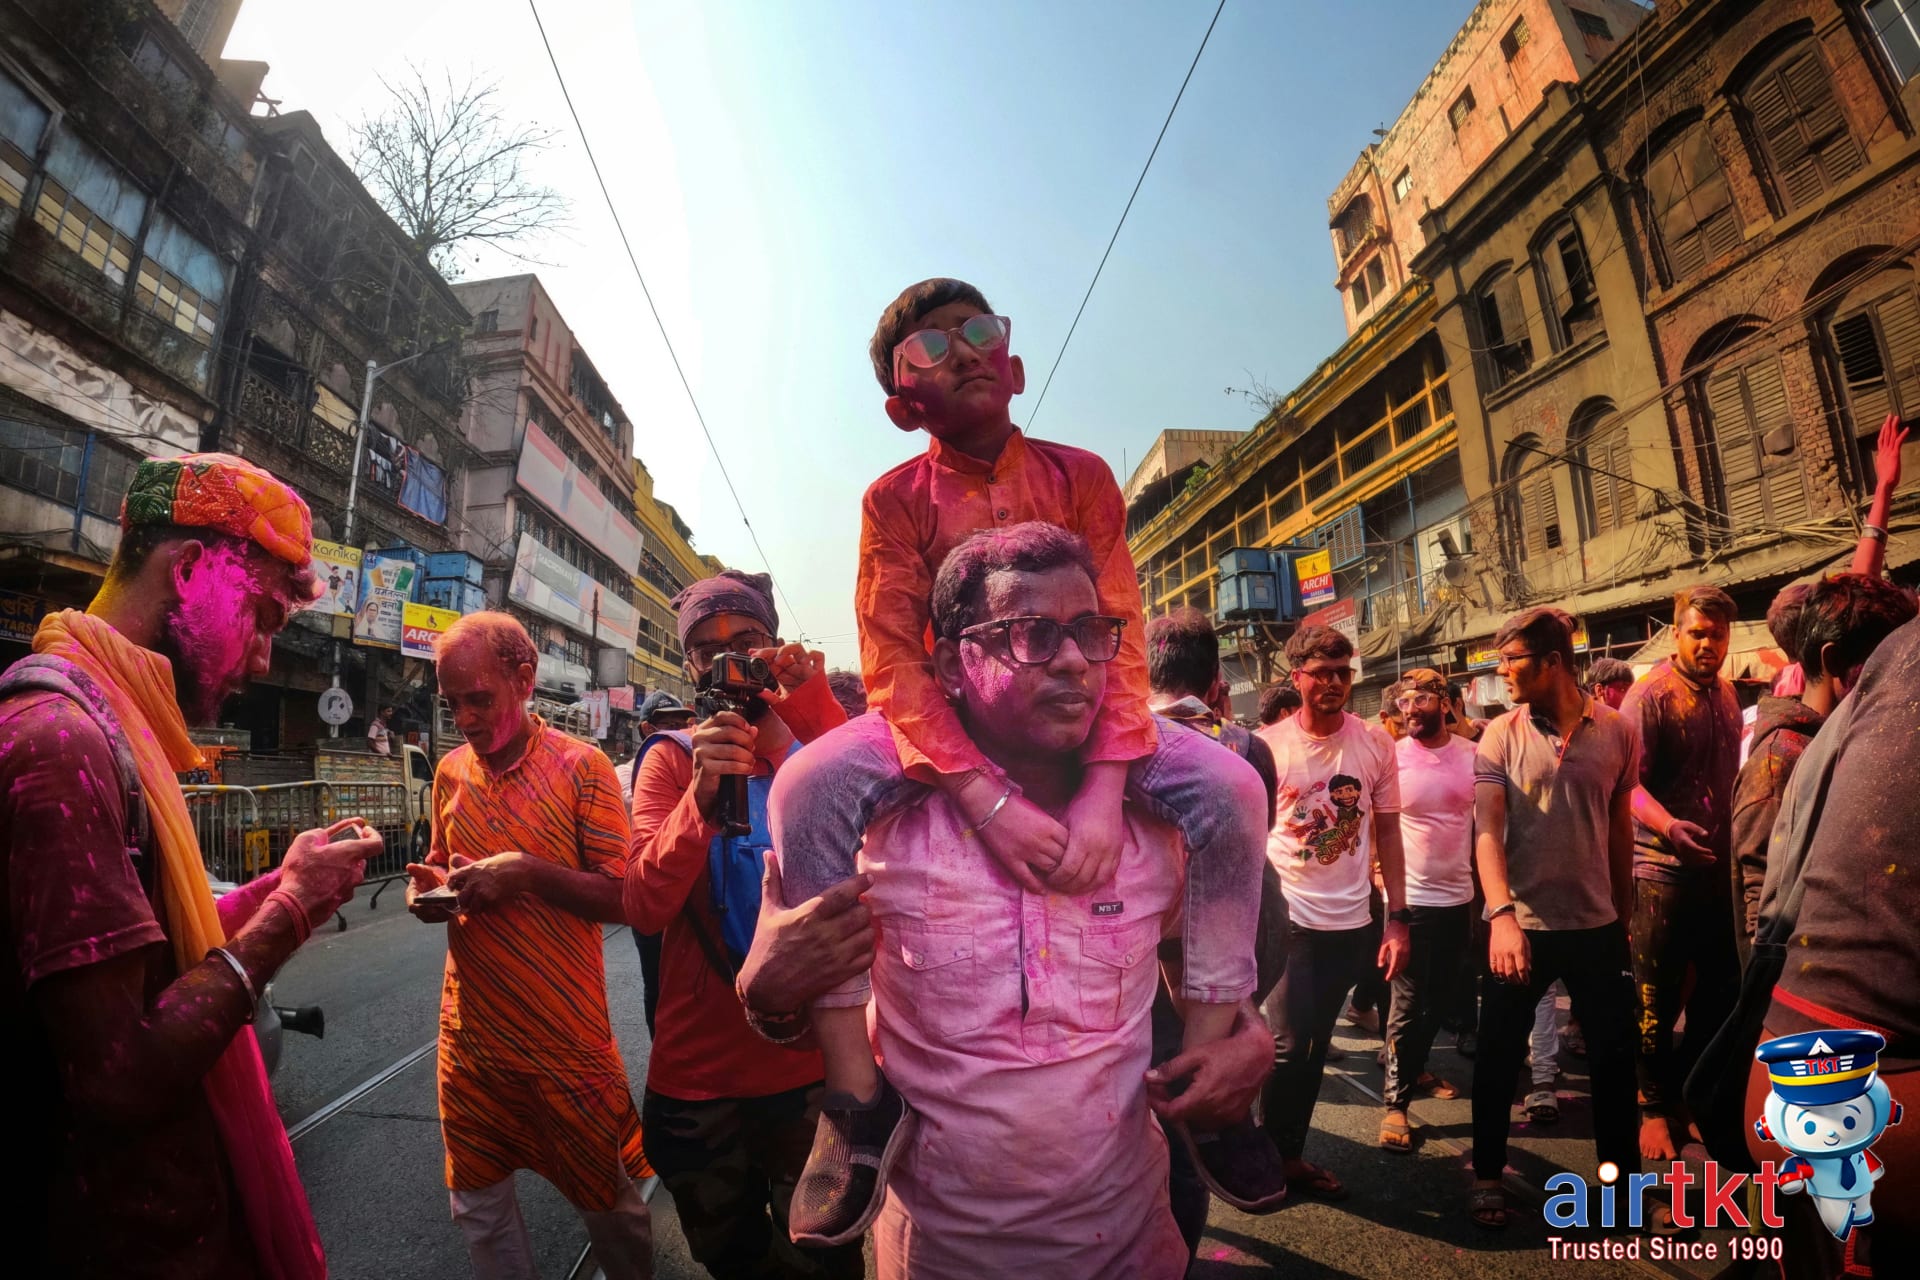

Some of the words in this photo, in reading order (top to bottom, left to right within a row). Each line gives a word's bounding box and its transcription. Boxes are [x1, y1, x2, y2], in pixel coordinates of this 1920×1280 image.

[313, 543, 358, 561] Karnika
[1302, 575, 1329, 591] ARCHI
[405, 628, 438, 643] ARC
